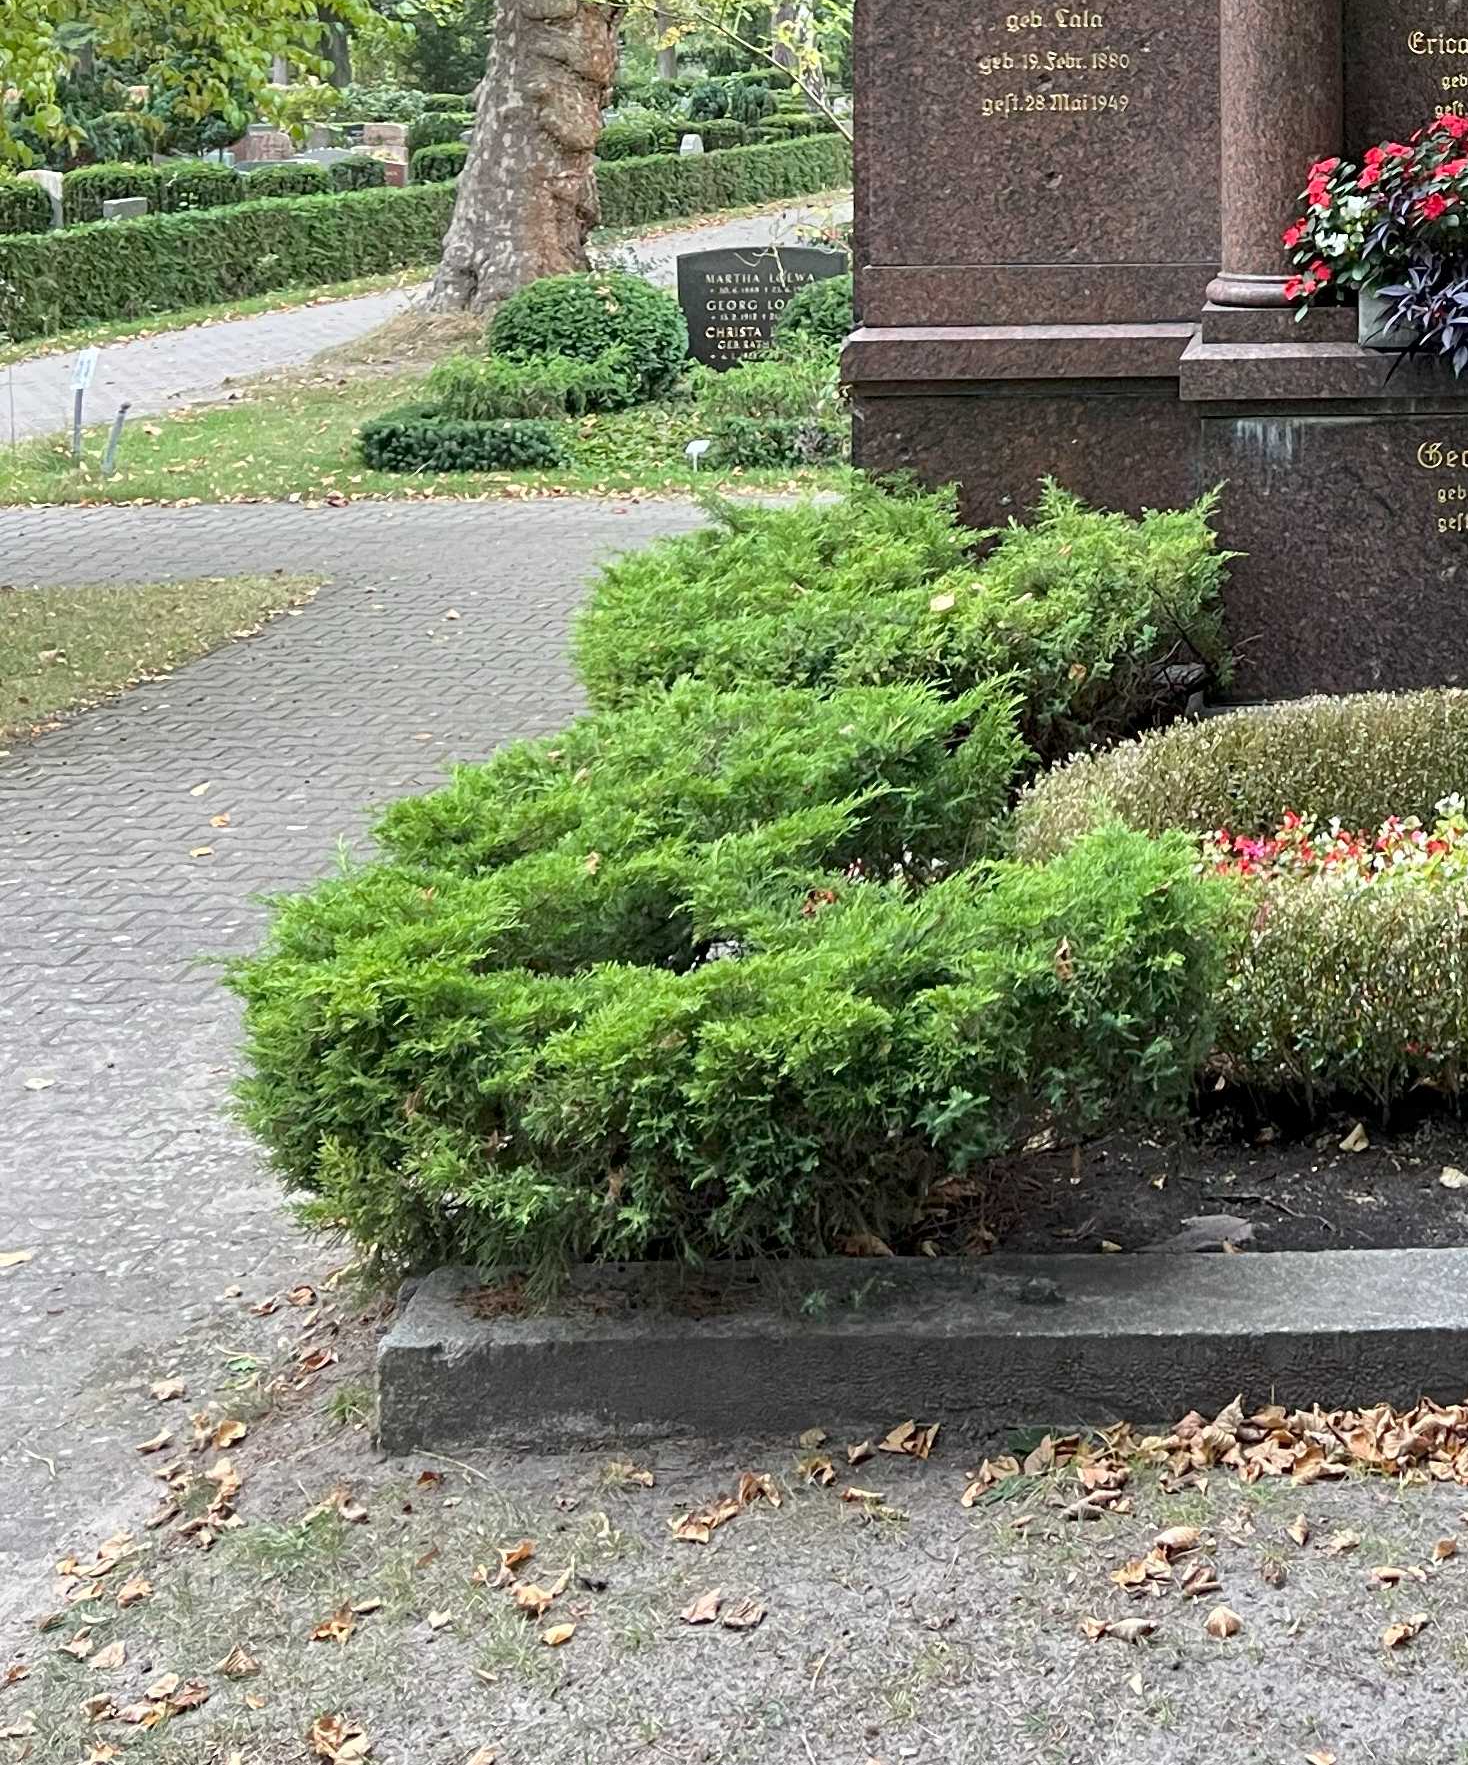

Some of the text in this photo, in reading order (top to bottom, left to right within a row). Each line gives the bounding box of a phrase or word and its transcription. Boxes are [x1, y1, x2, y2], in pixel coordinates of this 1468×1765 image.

[1055, 8, 1103, 28] Lala
[1022, 53, 1041, 70] 19.
[1043, 51, 1087, 71] Febr.
[1091, 52, 1130, 69] 1880
[1050, 94, 1088, 111] Mai
[1091, 94, 1129, 112] 1949
[705, 273, 760, 284] MARTHA
[706, 299, 758, 311] GEORG
[705, 326, 762, 338] CHRISTA
